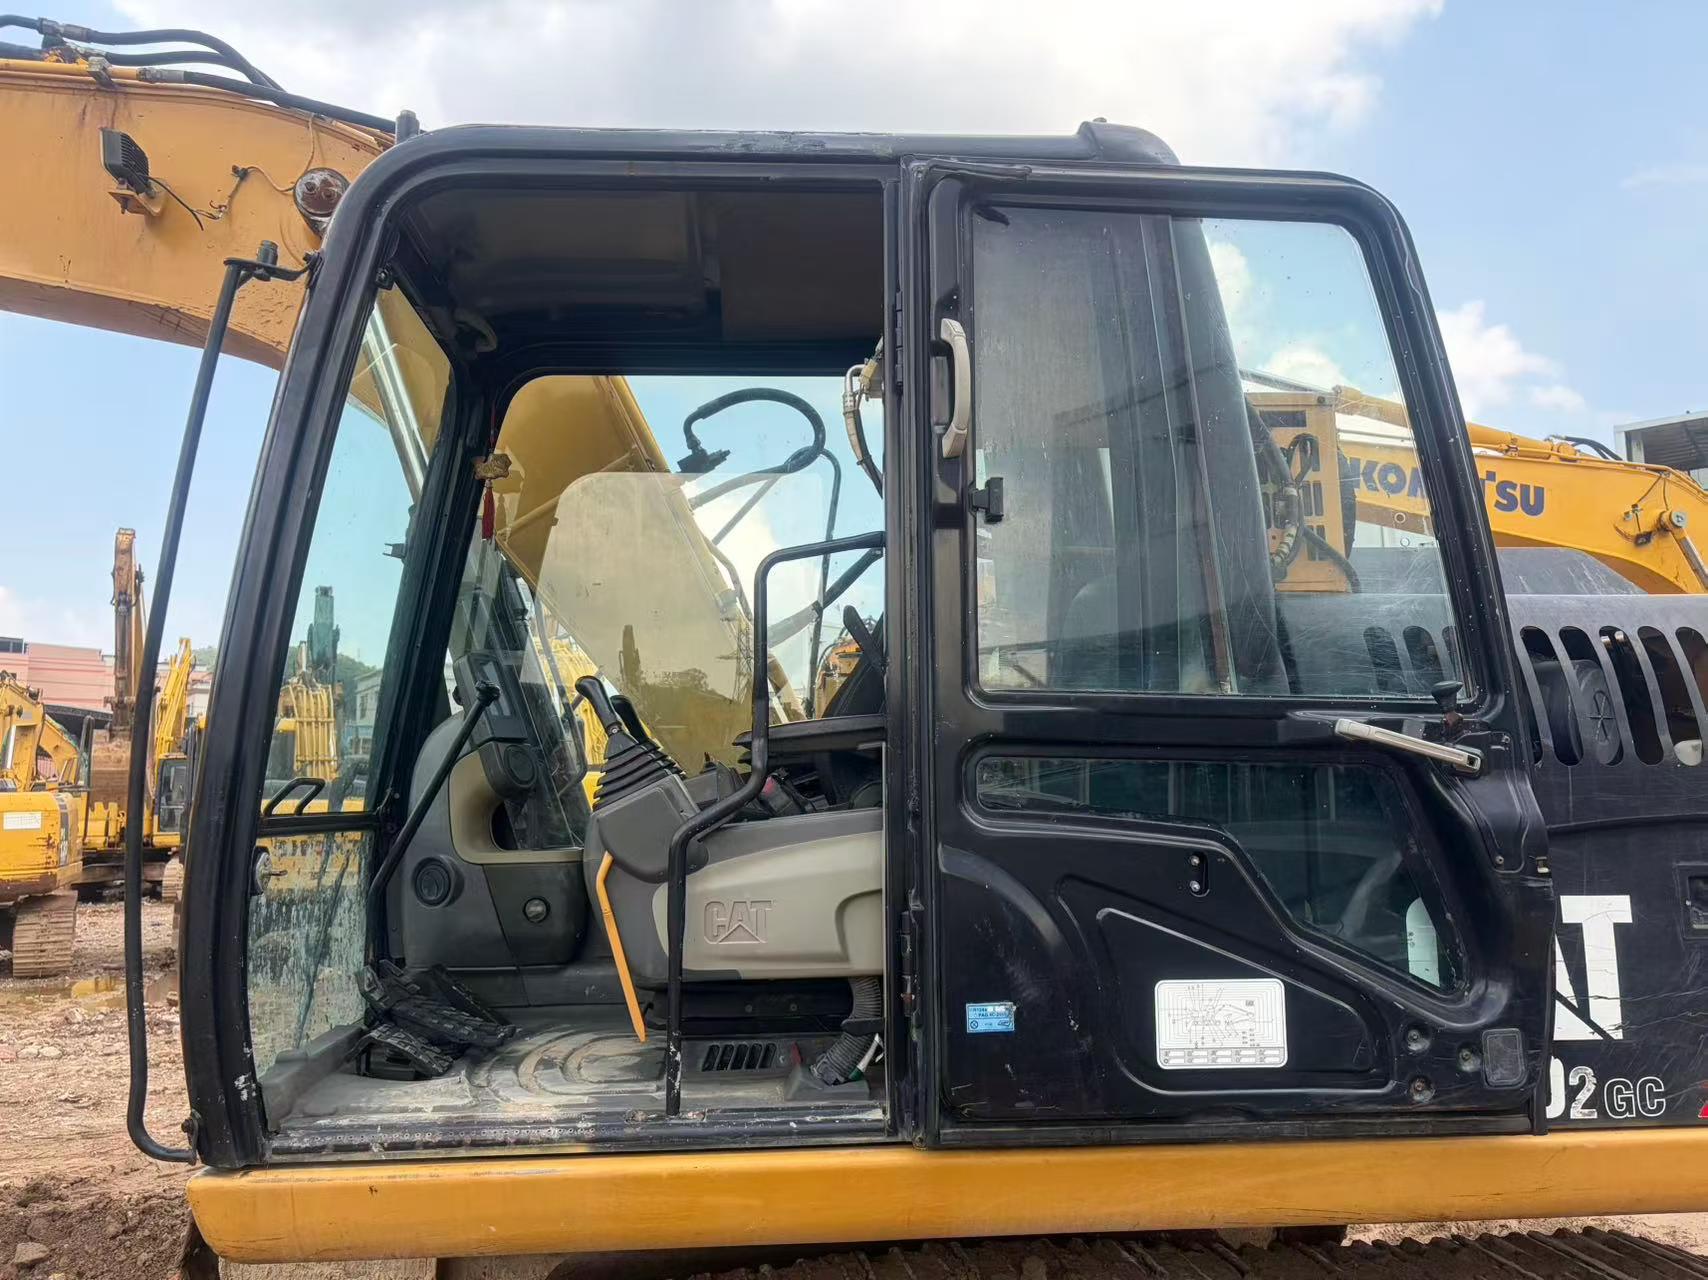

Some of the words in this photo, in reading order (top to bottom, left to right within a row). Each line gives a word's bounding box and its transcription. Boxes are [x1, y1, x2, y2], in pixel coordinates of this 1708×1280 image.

[1350, 457, 1545, 516] KOSU
[704, 900, 773, 944] CAT
[1604, 1076, 1666, 1119] GC
